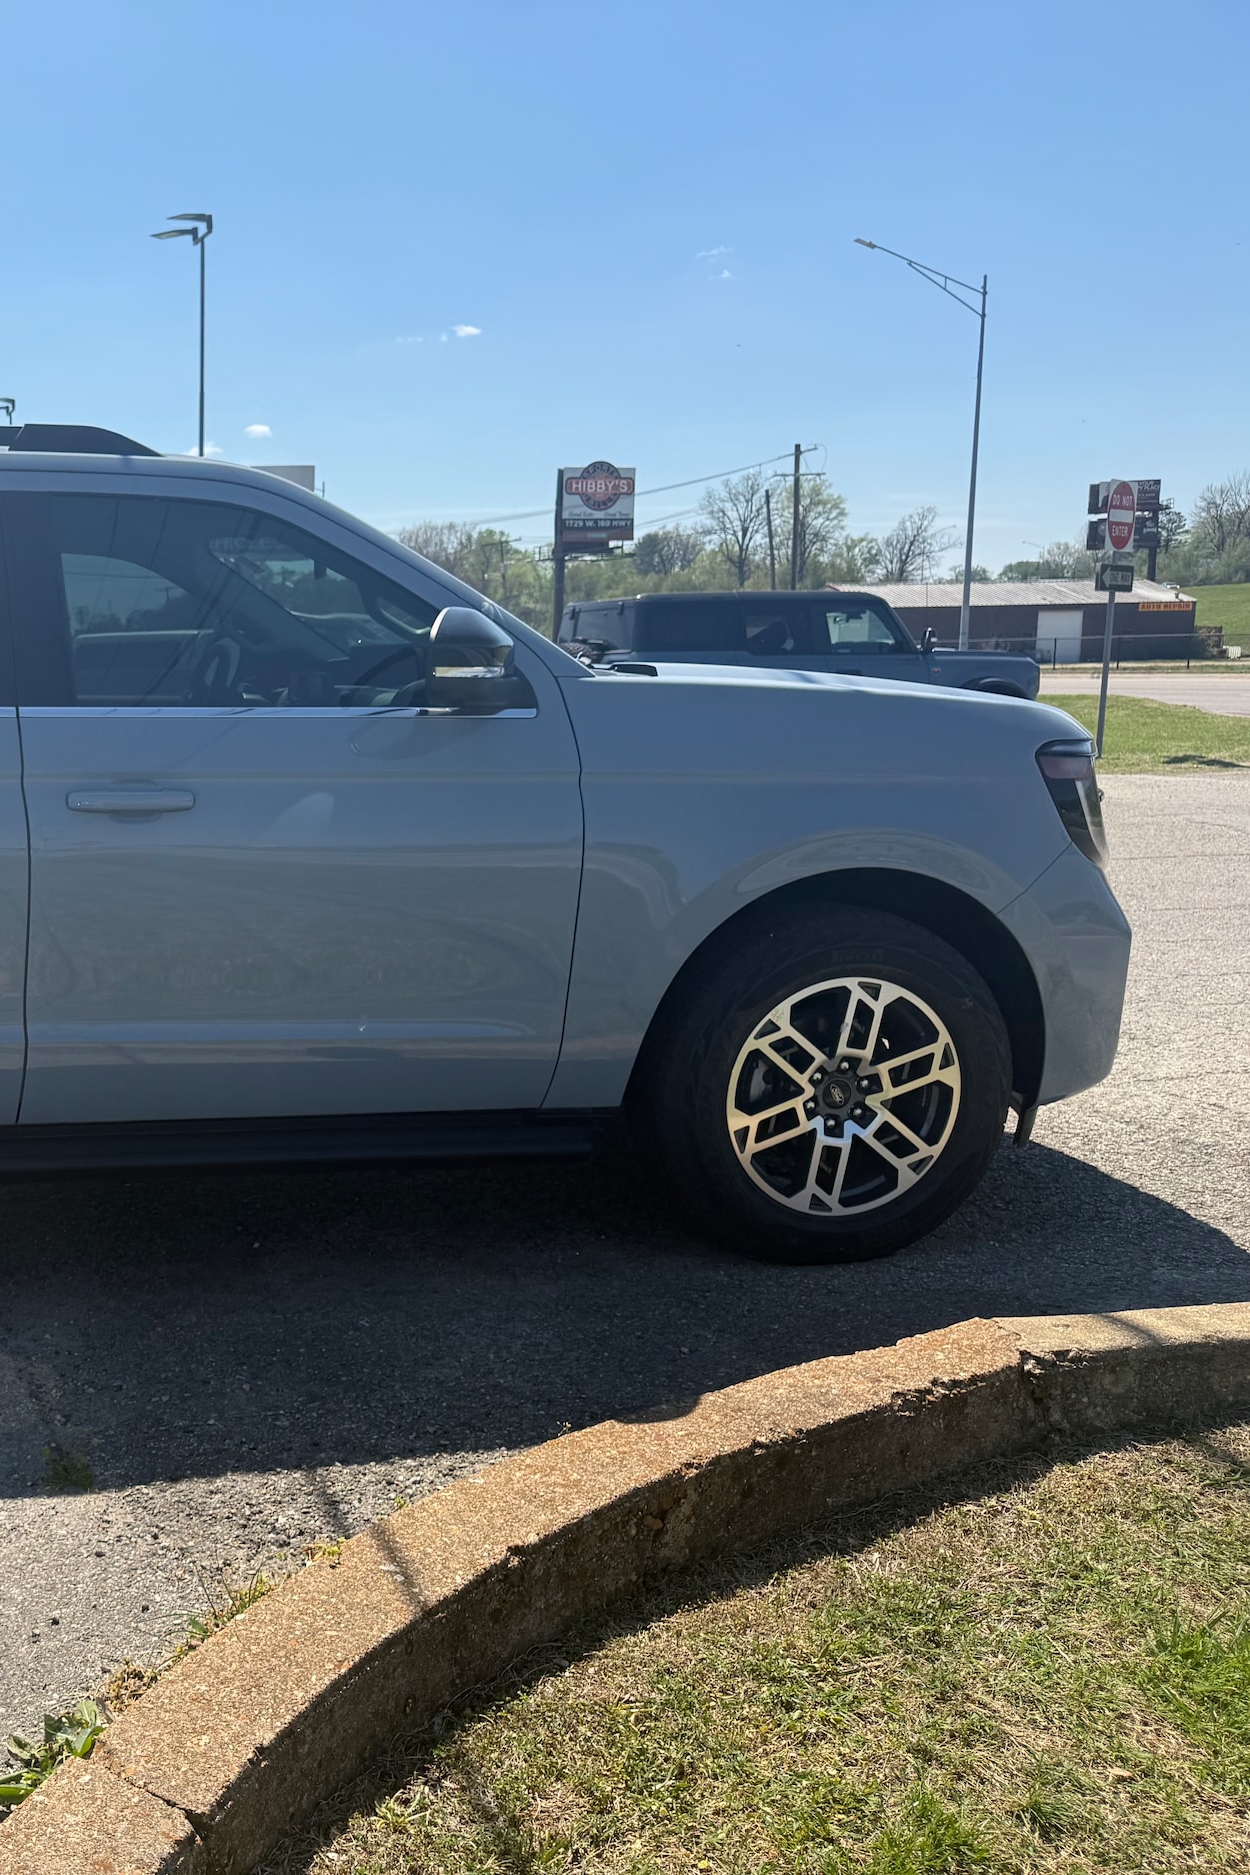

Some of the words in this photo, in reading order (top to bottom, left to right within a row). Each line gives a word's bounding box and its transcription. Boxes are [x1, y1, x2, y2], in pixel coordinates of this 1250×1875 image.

[572, 481, 628, 492] HIBBY'S
[1112, 494, 1121, 505] DO
[1122, 495, 1133, 507] NOT
[1112, 525, 1128, 537] ENTER
[1140, 602, 1161, 610] AUTO
[1163, 602, 1191, 610] REPAIR
